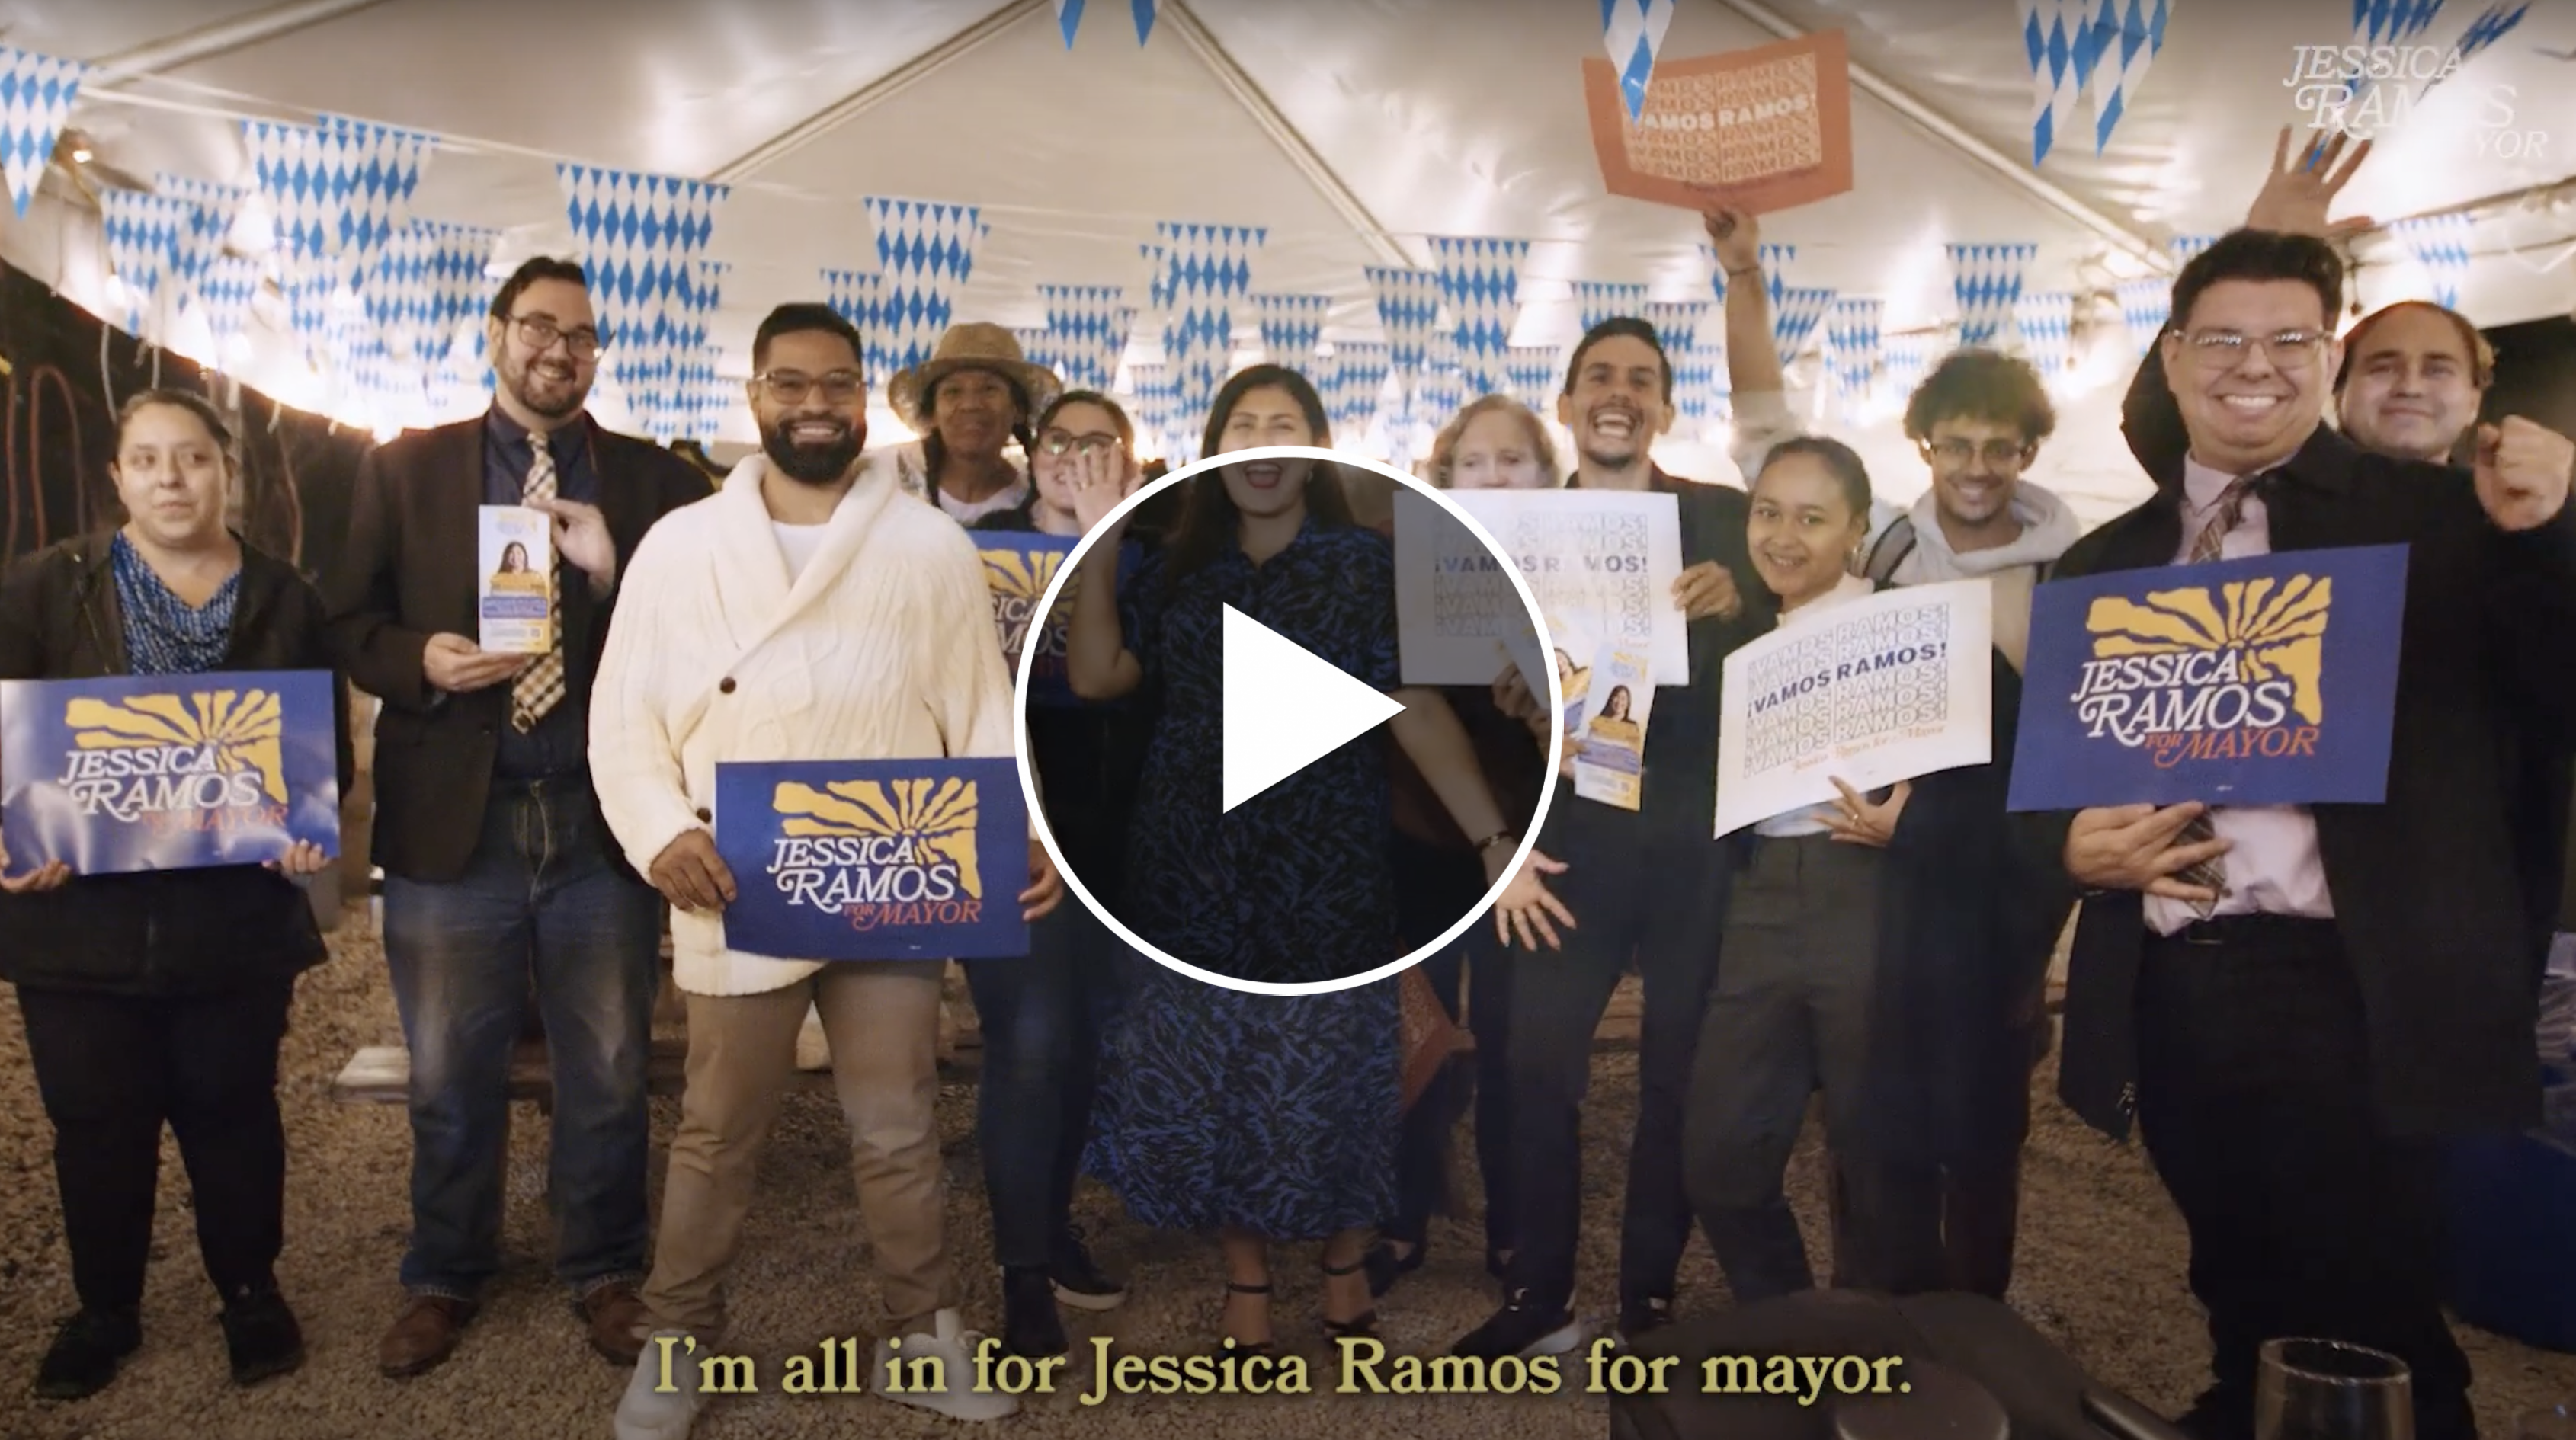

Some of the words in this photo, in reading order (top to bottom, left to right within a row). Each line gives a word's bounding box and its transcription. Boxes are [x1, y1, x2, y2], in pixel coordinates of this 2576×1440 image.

[1645, 111, 1715, 131] AMOS
[1543, 554, 1648, 574] RMOS!
[1747, 668, 1832, 719] ¡VAMOS
[1836, 641, 1948, 682] RAMOS!
[2071, 649, 2239, 702] JESSICA
[1834, 701, 1948, 744] RAMOS!
[2078, 680, 2291, 747] RAMOS
[2143, 732, 2182, 749] FOR
[2154, 726, 2321, 770] MAYOR
[58, 746, 217, 785] JESSICA
[69, 771, 261, 822] RAMOS
[766, 837, 915, 874] JESSICA
[776, 864, 958, 914] RAMOS
[844, 905, 875, 917] FOR
[852, 901, 982, 931] MAYOR
